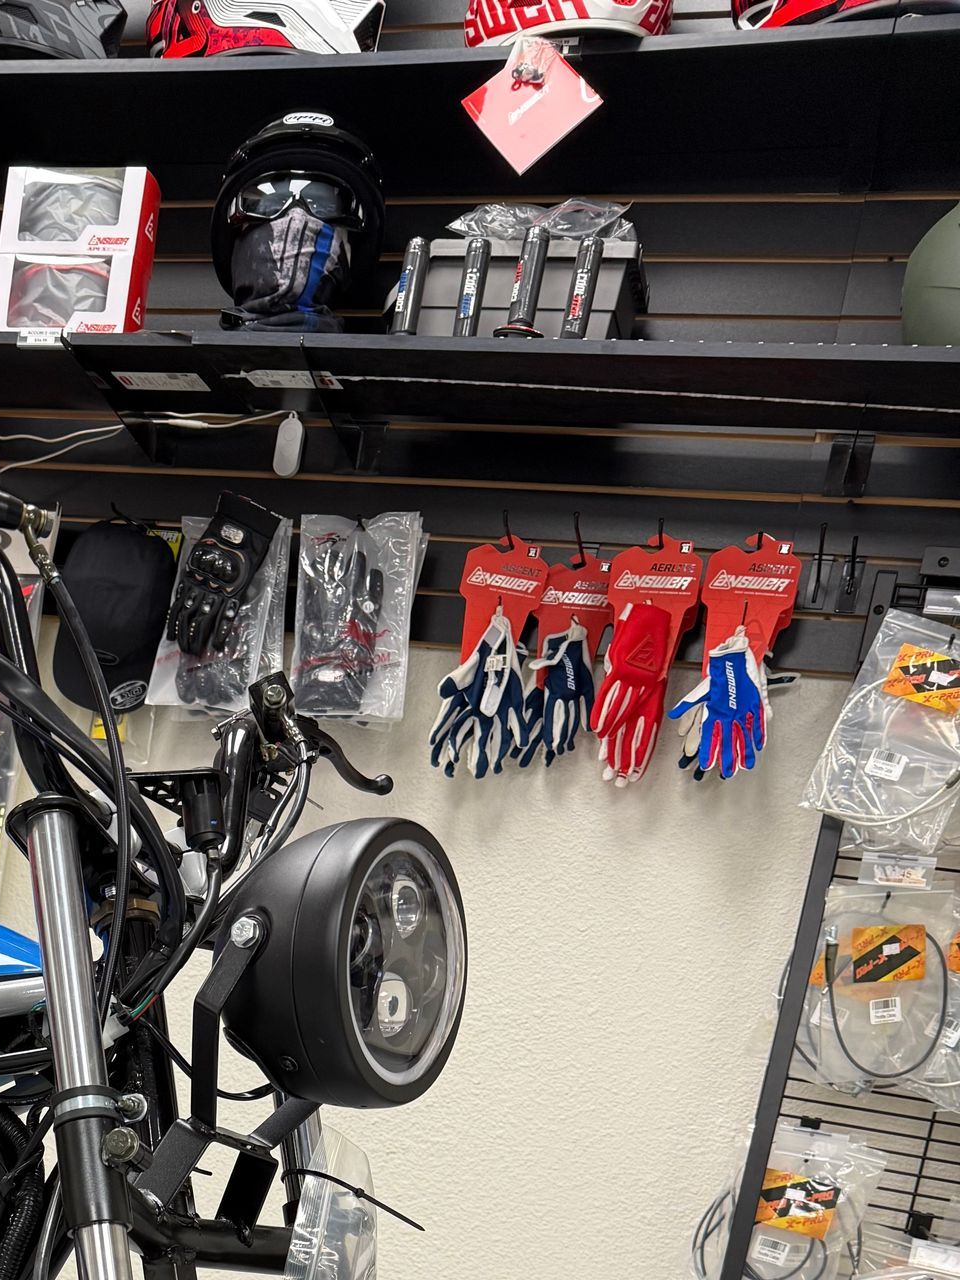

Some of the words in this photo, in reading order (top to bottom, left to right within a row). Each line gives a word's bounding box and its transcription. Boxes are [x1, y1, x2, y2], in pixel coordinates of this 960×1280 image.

[467, 567, 540, 593] ANSWER
[614, 570, 694, 590] ANSWER
[709, 570, 793, 591] ANSWER
[767, 1172, 794, 1183] -PRO
